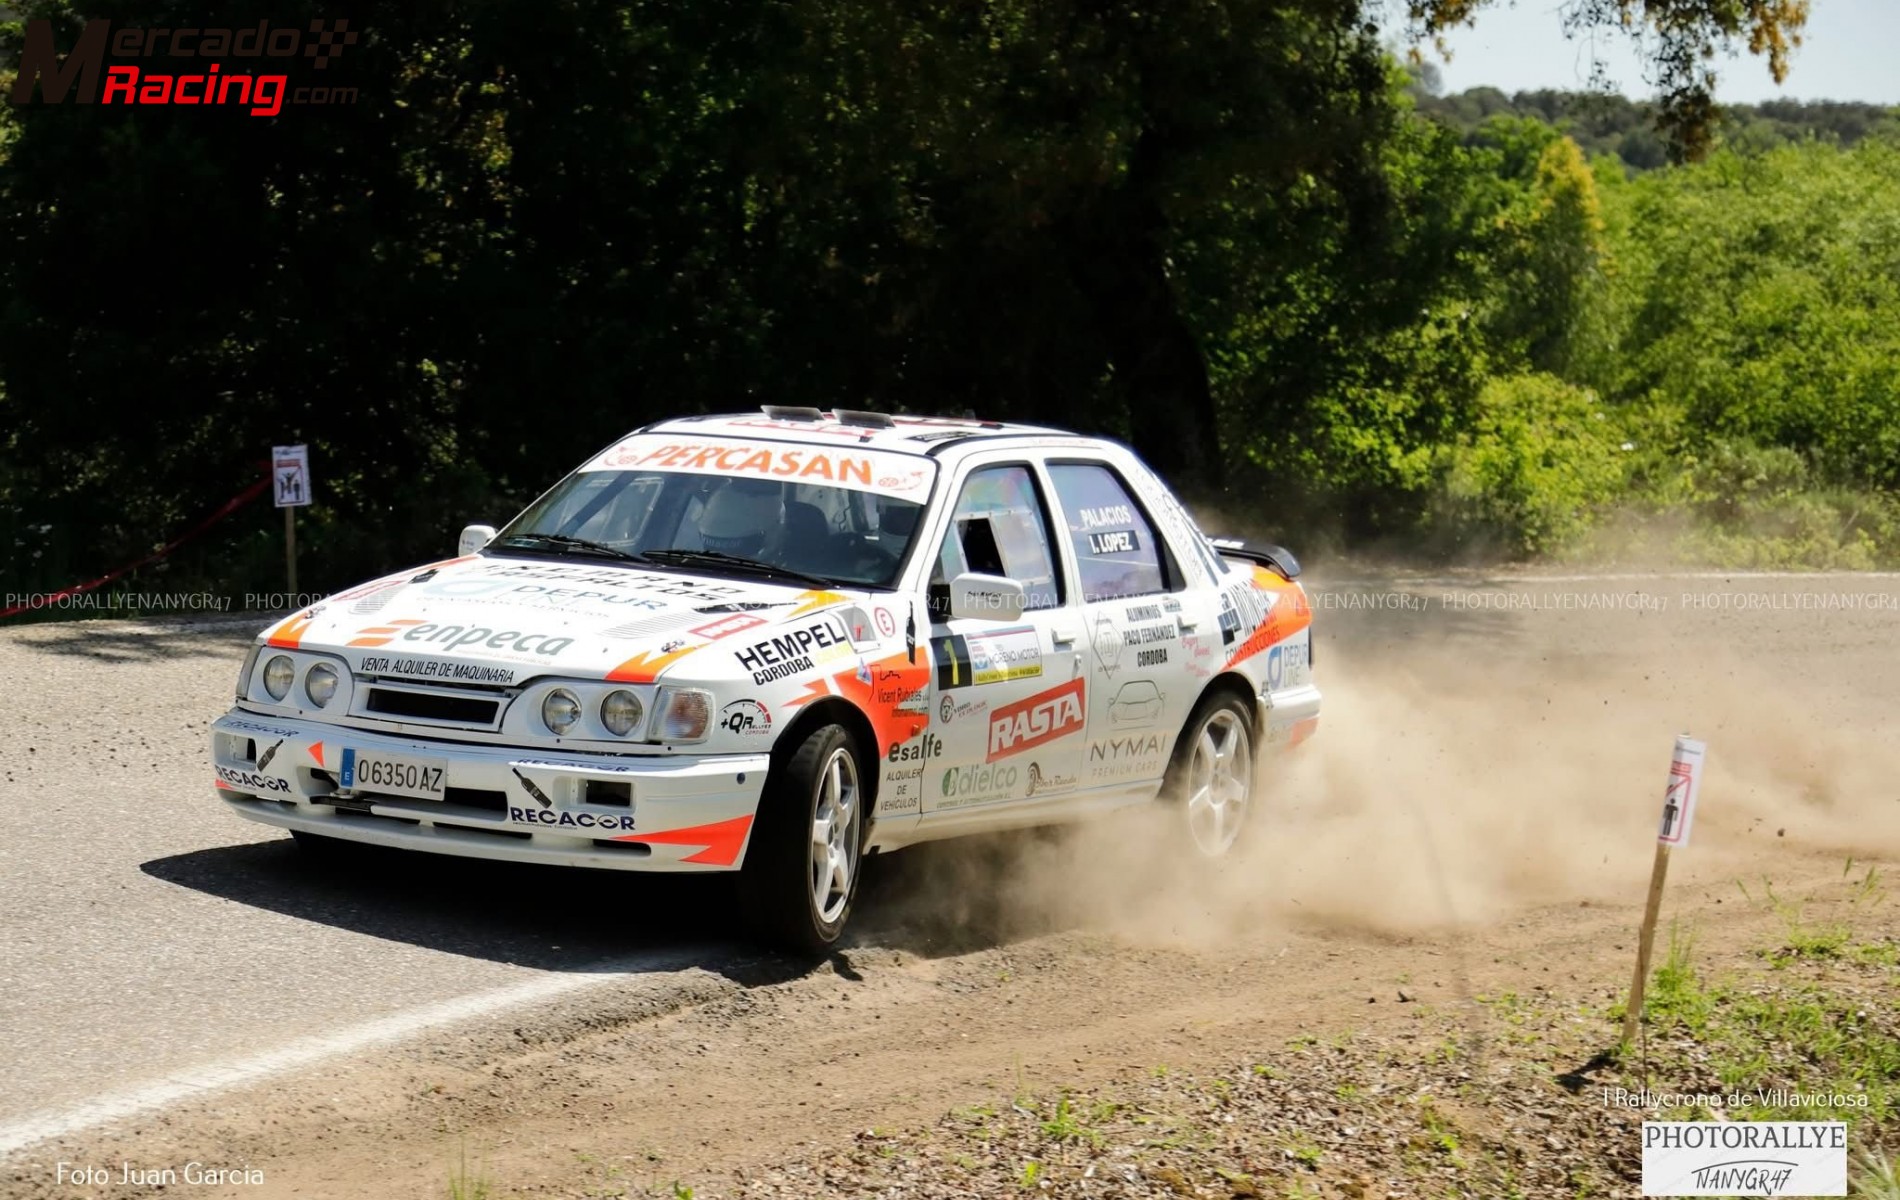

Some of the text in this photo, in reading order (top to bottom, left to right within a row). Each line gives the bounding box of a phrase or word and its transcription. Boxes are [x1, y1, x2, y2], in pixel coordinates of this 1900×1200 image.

[636, 445, 872, 485] PERCASAN
[1080, 506, 1131, 527] PALACIOS
[512, 585, 667, 609] DEPUR
[1126, 604, 1162, 622] ALUMINIOS
[403, 624, 575, 656] enpeca
[734, 622, 846, 671] HEMPEL
[1123, 628, 1141, 646] PACO
[943, 639, 959, 685] 1
[1137, 648, 1168, 667] CORDOBA
[1284, 644, 1307, 667] DEPUR
[361, 657, 515, 683] VENTA ALQUILER DE MAQUINARIA
[753, 656, 814, 686] CORDOBA
[991, 692, 1083, 754] RASTA
[888, 733, 942, 762] esalfe
[1090, 734, 1166, 761] NYMAI
[215, 764, 292, 793] RECACOR
[886, 768, 922, 782] ALQUILER
[959, 763, 1018, 795] dielco
[896, 785, 907, 796] DE
[510, 807, 635, 831] RECACOR
